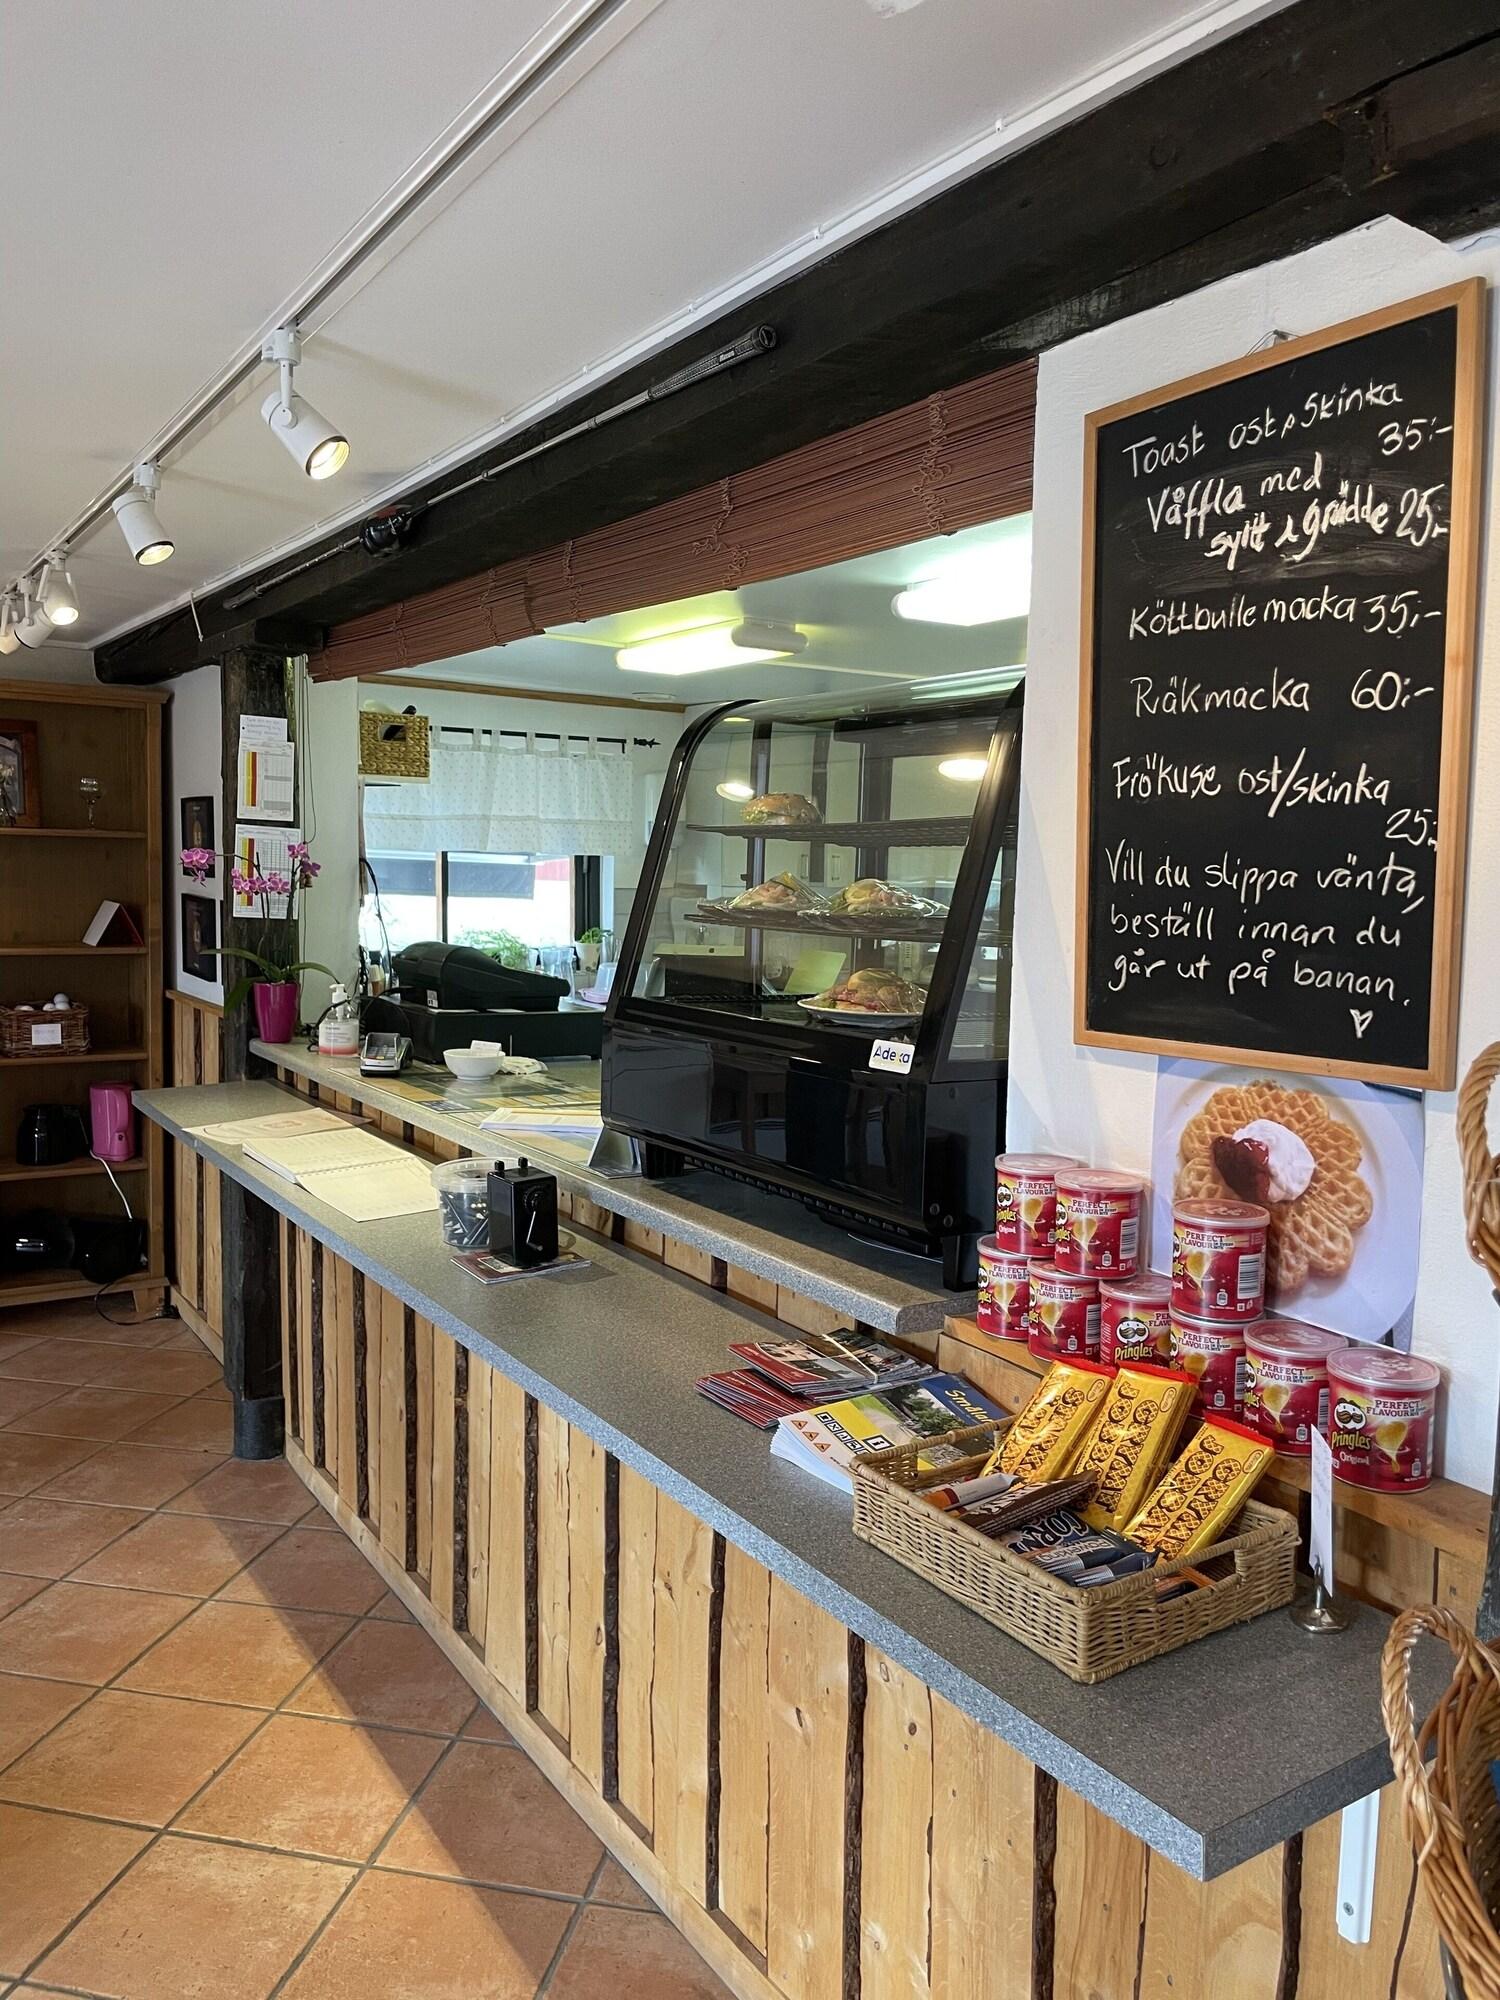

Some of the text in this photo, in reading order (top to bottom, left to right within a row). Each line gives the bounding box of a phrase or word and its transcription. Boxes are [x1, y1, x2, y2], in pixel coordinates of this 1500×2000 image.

[1122, 420, 1208, 478] Toast
[1228, 405, 1277, 450] ost
[1377, 416, 1454, 456] 35:-
[1146, 451, 1323, 540] Våffla med
[1203, 511, 1275, 571] sylt
[1281, 479, 1390, 563] grädde
[1128, 593, 1257, 641] Köttbulle
[1263, 584, 1358, 623] macka
[1129, 666, 1311, 718] Räkmacka
[1237, 746, 1392, 818] ost/skinka
[1104, 838, 1425, 915] Vill du slippa vänta,
[1110, 901, 1402, 948] beställ innan du
[1107, 948, 1411, 1007] går ut på banan.
[1013, 1187, 1045, 1196] FLAVOUR
[1018, 1181, 1054, 1191] PERFECT
[1067, 1206, 1100, 1216] FLAVOUR
[1072, 1199, 1109, 1210] PERFECT
[1180, 1236, 1214, 1250] FLAVOUR
[1185, 1230, 1225, 1243] PERFECT
[988, 1269, 1019, 1280] FLAVOUR
[993, 1264, 1028, 1275] PERFECT
[1036, 1288, 1066, 1300] FLAVOUR
[1040, 1282, 1075, 1294] PERFECT
[1148, 1320, 1171, 1328] FLAV
[1178, 1337, 1212, 1351] FLAVOUR
[1183, 1331, 1222, 1345] PERFECT
[1114, 1343, 1153, 1362] Pringles
[1256, 1367, 1293, 1382] FLAVOUR
[1262, 1361, 1305, 1376] PERFECT
[1366, 1406, 1412, 1418] FLAVOUR
[1374, 1399, 1420, 1410] PERFECT
[1084, 1380, 1141, 1480] JOBBA
[1331, 1430, 1371, 1450] Pringles
[1095, 1399, 1160, 1514] GRYMT
[1339, 1451, 1370, 1465] Original
[1157, 1457, 1243, 1563] GRYMT
